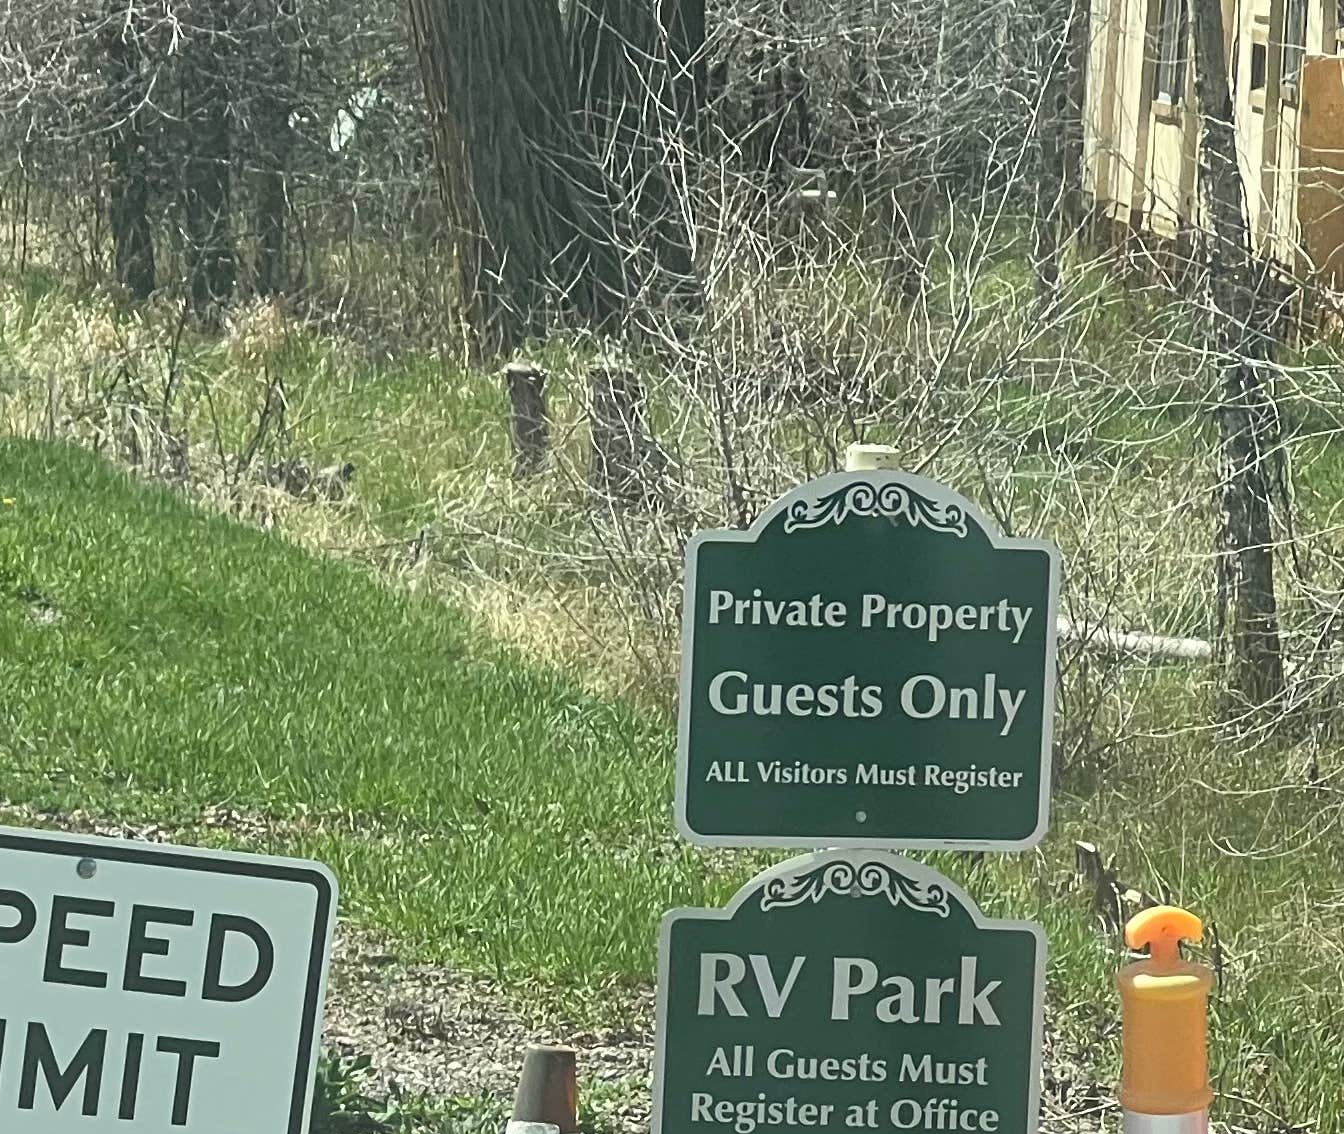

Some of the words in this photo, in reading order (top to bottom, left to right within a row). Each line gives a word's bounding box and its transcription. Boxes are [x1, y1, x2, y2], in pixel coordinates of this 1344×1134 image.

[708, 588, 847, 628] Private
[861, 594, 1033, 644] Property
[708, 670, 883, 718] Guests
[900, 673, 1027, 736] Only
[705, 760, 750, 783] ALL
[756, 760, 848, 785] Visitors
[855, 763, 916, 786] Must
[924, 764, 1023, 794] Register
[697, 952, 807, 1018] RV
[830, 955, 1003, 1026] Park
[705, 1045, 754, 1077] All
[766, 1048, 887, 1082] Guests
[898, 1053, 989, 1086] Must
[691, 1092, 834, 1134] Register
[845, 1099, 879, 1128] at
[890, 1097, 999, 1132] Office
